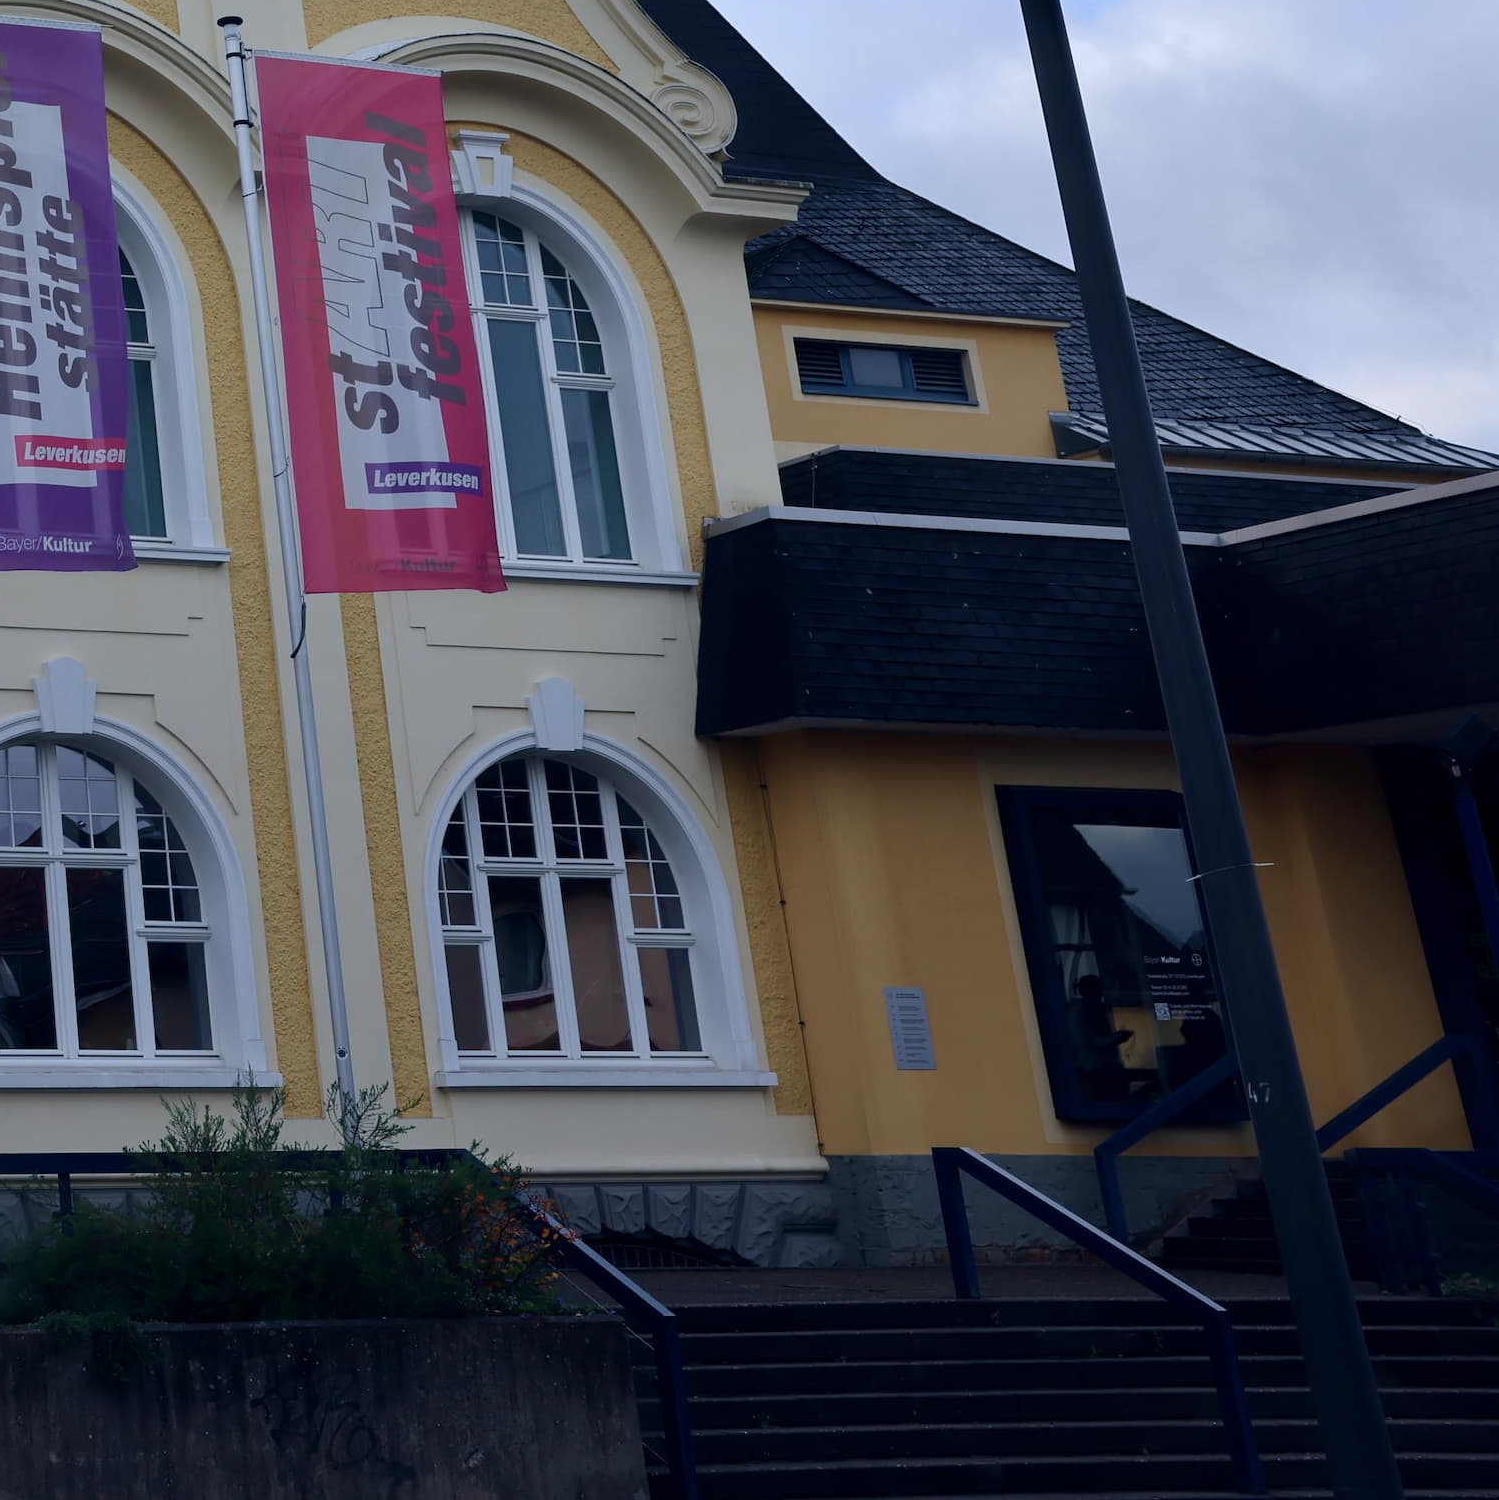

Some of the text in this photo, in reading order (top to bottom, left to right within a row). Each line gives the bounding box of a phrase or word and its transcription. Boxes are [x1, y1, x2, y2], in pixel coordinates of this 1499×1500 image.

[37, 194, 99, 395] stätte
[273, 128, 400, 436] stART
[365, 111, 467, 406] festival
[23, 440, 126, 467] Leverkusen
[373, 466, 480, 493] Leverkusen
